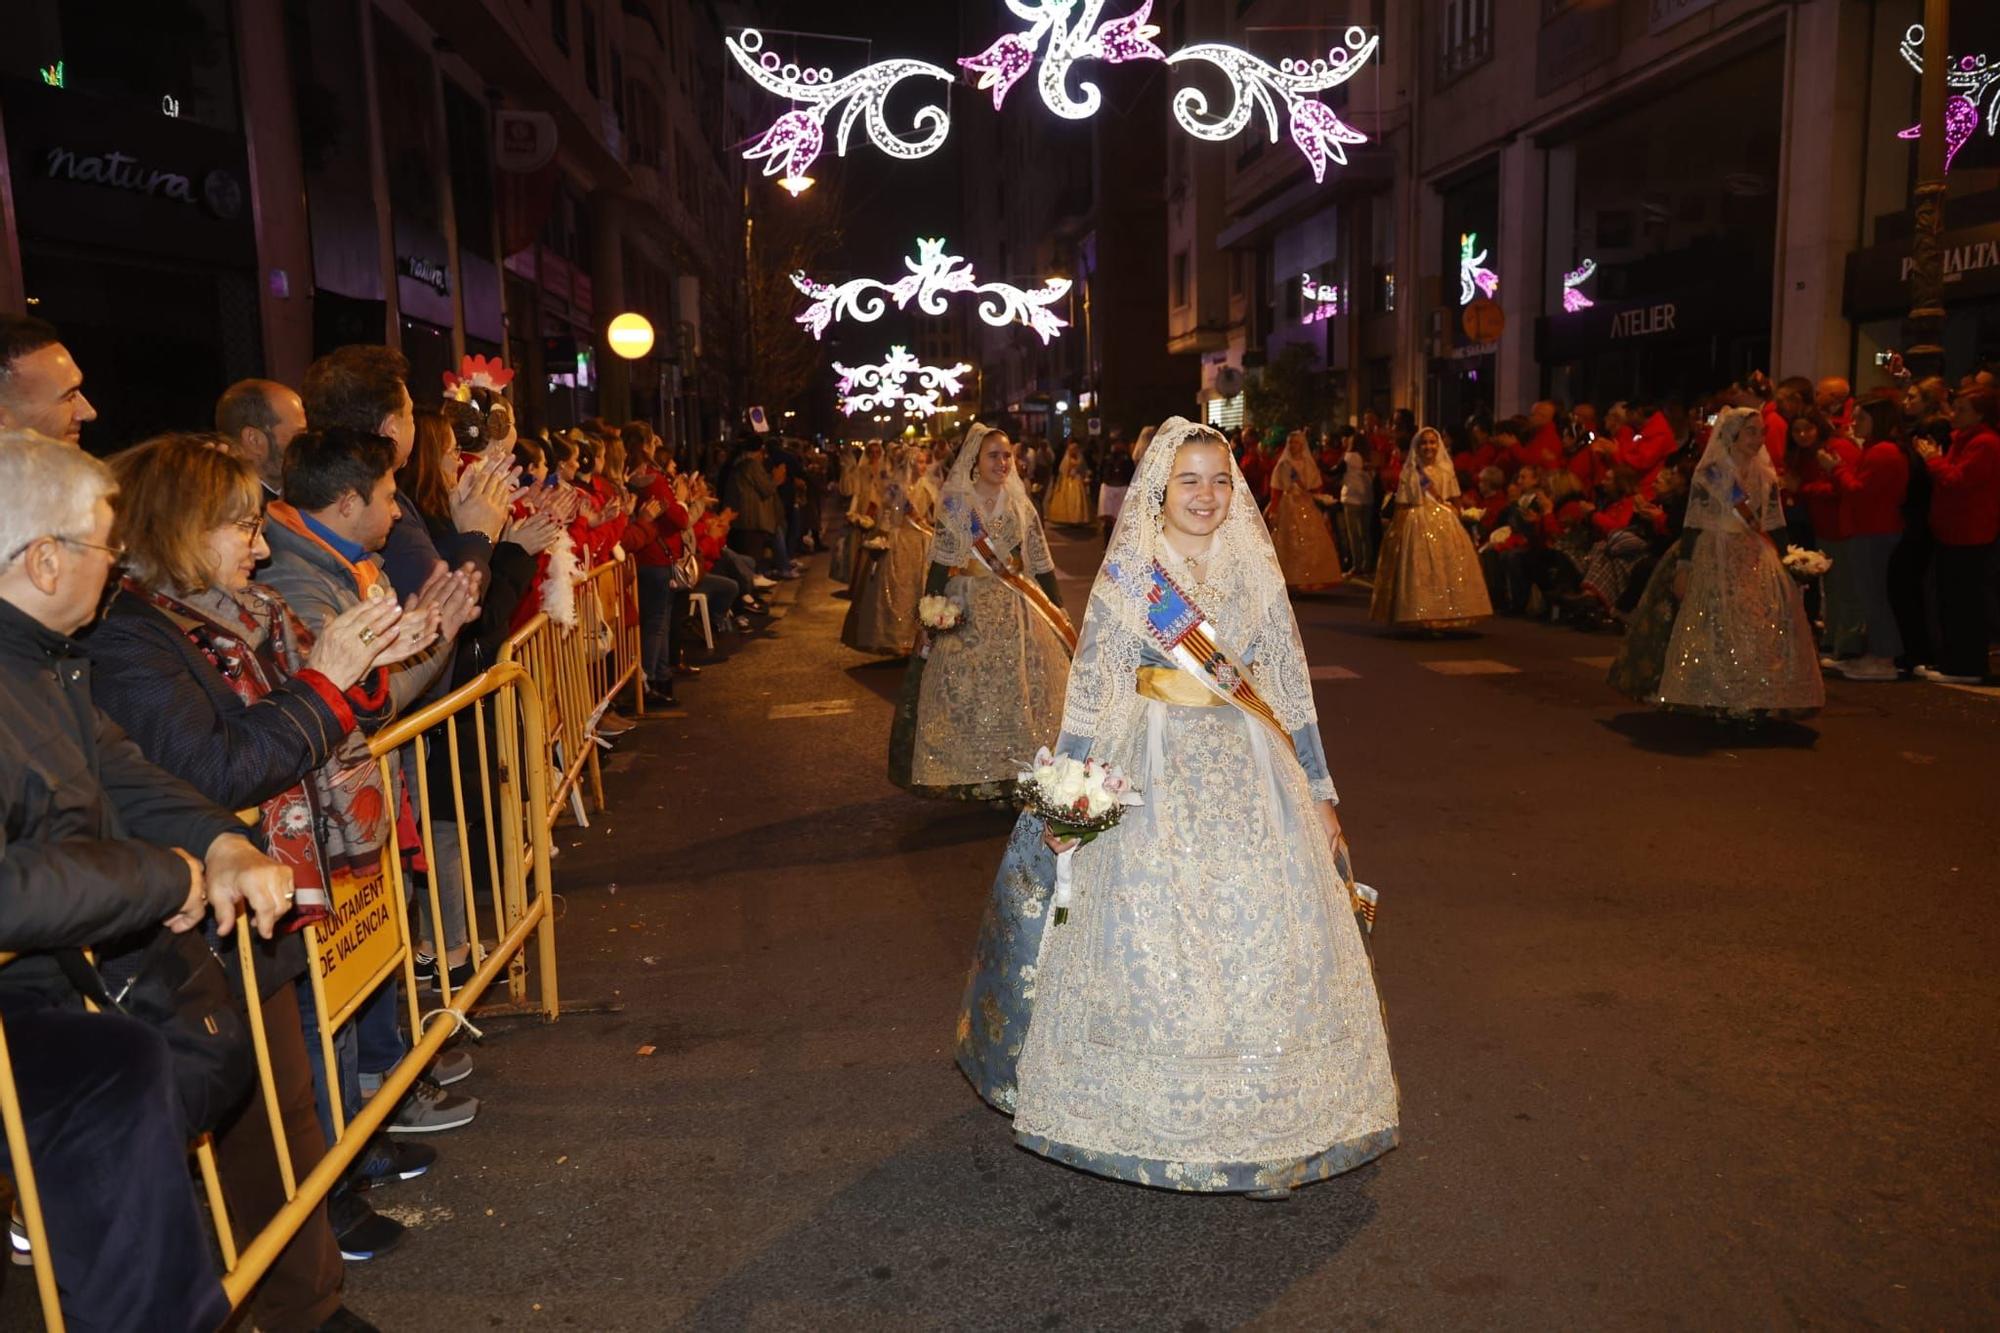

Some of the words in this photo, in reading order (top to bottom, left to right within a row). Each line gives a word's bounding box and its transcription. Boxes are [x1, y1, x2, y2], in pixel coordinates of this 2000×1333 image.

[47, 145, 198, 203] natura
[1609, 303, 1676, 339] ATELIER
[320, 949, 336, 978] DE
[336, 903, 390, 961] VALÈNCIA
